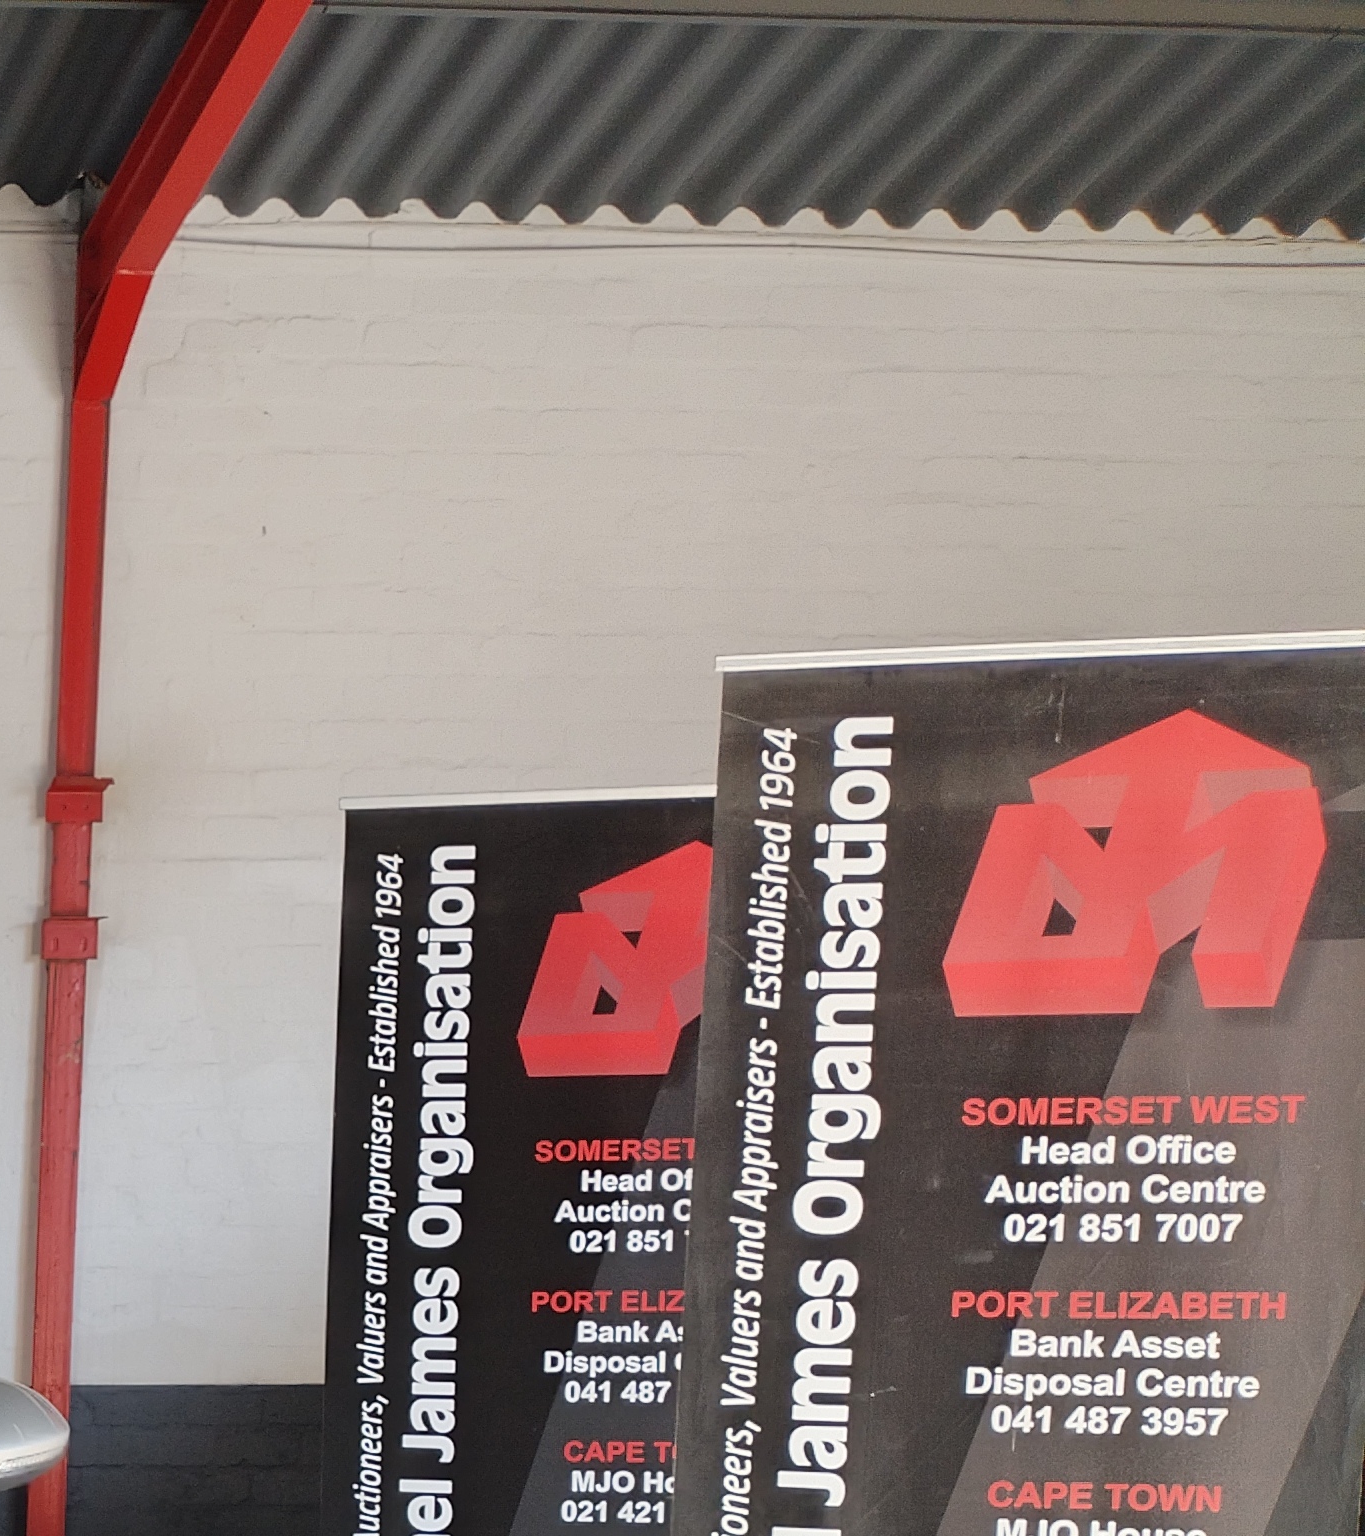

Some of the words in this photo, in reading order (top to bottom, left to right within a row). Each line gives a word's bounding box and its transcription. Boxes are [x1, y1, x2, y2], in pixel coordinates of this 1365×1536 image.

[759, 728, 797, 810] 1964
[375, 854, 403, 917] 1964
[745, 819, 791, 1009] Established
[793, 716, 894, 1235] Organisation
[368, 924, 400, 1072] Established
[408, 846, 476, 1248] Organisation
[732, 1038, 778, 1211] Appraisers
[962, 1096, 1180, 1126] SOMERSET
[1191, 1095, 1305, 1123] WEST
[363, 1095, 396, 1230] Appraisers
[536, 1138, 694, 1162] SOMERSET
[1022, 1136, 1116, 1164] Head
[1126, 1134, 1236, 1164] Office
[581, 1169, 652, 1192] Head
[985, 1174, 1130, 1204] Auction
[1142, 1174, 1266, 1203] Centre
[555, 1200, 664, 1222] Auction
[570, 1230, 616, 1253] 021
[627, 1230, 673, 1252] 851
[1004, 1213, 1065, 1242] 021
[1079, 1213, 1140, 1242] 851
[1156, 1213, 1243, 1242] 7007
[360, 1234, 388, 1285] and
[729, 1216, 766, 1281] and
[532, 1291, 612, 1313] PORT
[952, 1290, 1058, 1318] PORT
[1069, 1291, 1286, 1319] ELIZABETH
[356, 1291, 386, 1383] Valuers
[578, 1320, 649, 1343] Bank
[720, 1289, 761, 1405] Valuers
[1010, 1329, 1104, 1357] Bank
[1112, 1330, 1221, 1359] Asset
[402, 1267, 459, 1463] James
[544, 1351, 666, 1378] Disposal
[565, 1381, 610, 1403] 041
[621, 1381, 671, 1403] 487
[777, 1259, 859, 1507] James
[966, 1367, 1125, 1402] Disposal
[1136, 1368, 1260, 1398] Centre
[991, 1405, 1051, 1433] 041
[1064, 1406, 1131, 1434] 487
[1141, 1407, 1228, 1436] 3957
[564, 1440, 644, 1463] CAPE
[572, 1470, 635, 1493] MJO
[988, 1481, 1093, 1509] CAPE
[1105, 1483, 1221, 1512] TOWN
[561, 1500, 607, 1522] 021
[617, 1501, 664, 1523] 421
